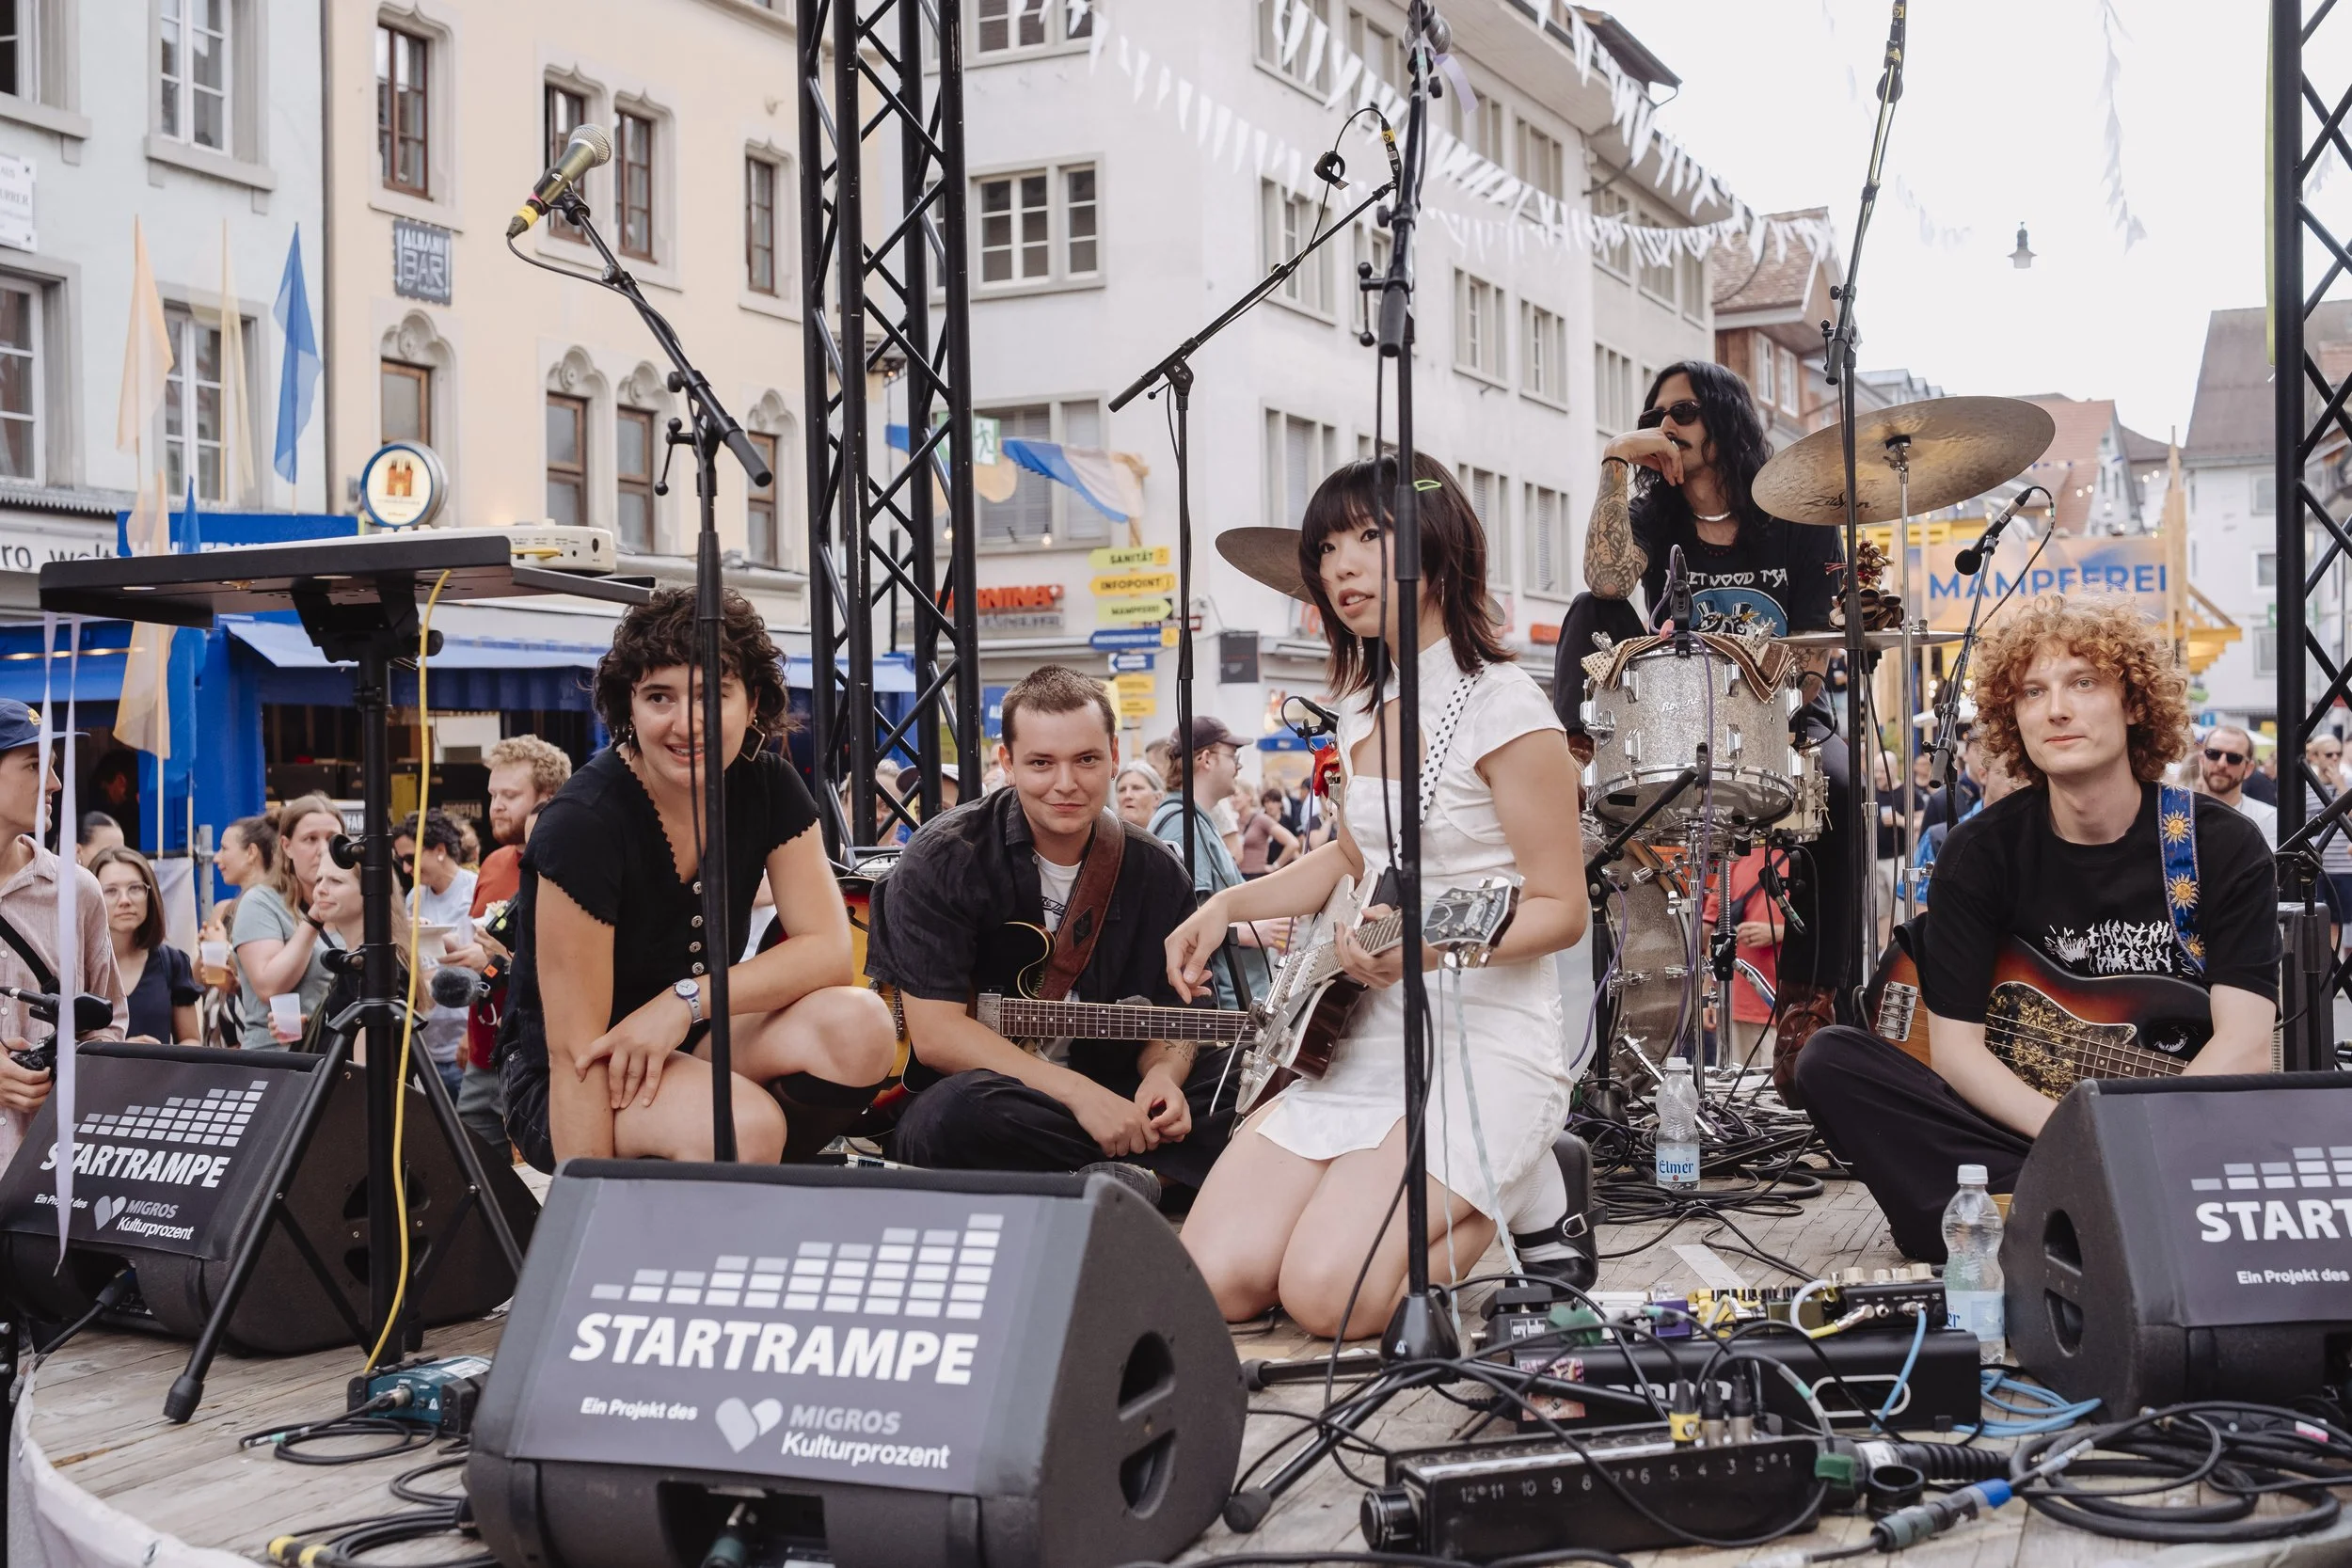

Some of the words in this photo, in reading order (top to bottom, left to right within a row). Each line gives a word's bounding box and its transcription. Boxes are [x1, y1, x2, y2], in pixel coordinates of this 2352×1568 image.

[403, 249, 445, 288] BAR
[1100, 578, 1161, 591] INFOPOINT
[40, 1141, 231, 1189] SARTRAMPE
[1659, 1160, 1694, 1174] Elmer
[34, 1193, 48, 1205] Ein
[73, 1196, 88, 1210] des
[125, 1199, 180, 1220] MIGROS
[116, 1216, 195, 1241] Kulturprozent
[2235, 1271, 2263, 1285] Ein
[2264, 1269, 2320, 1286] Projekt
[2321, 1267, 2351, 1283] des
[568, 1312, 979, 1386] STARTRAMPE
[580, 1397, 608, 1416] Ein
[609, 1398, 666, 1419] Projekt
[667, 1402, 698, 1421] des
[788, 1403, 901, 1435] MIGROS
[780, 1431, 950, 1470] Kulturprozent
[1460, 1485, 1477, 1503] 12
[1490, 1482, 1504, 1500] 11
[1521, 1479, 1537, 1497] 10
[1552, 1476, 1563, 1495] 9
[1581, 1473, 1592, 1491] 8
[1640, 1466, 1651, 1485] 6
[1669, 1464, 1680, 1481] 5
[1726, 1457, 1738, 1476] 3
[1755, 1455, 1765, 1473] 2
